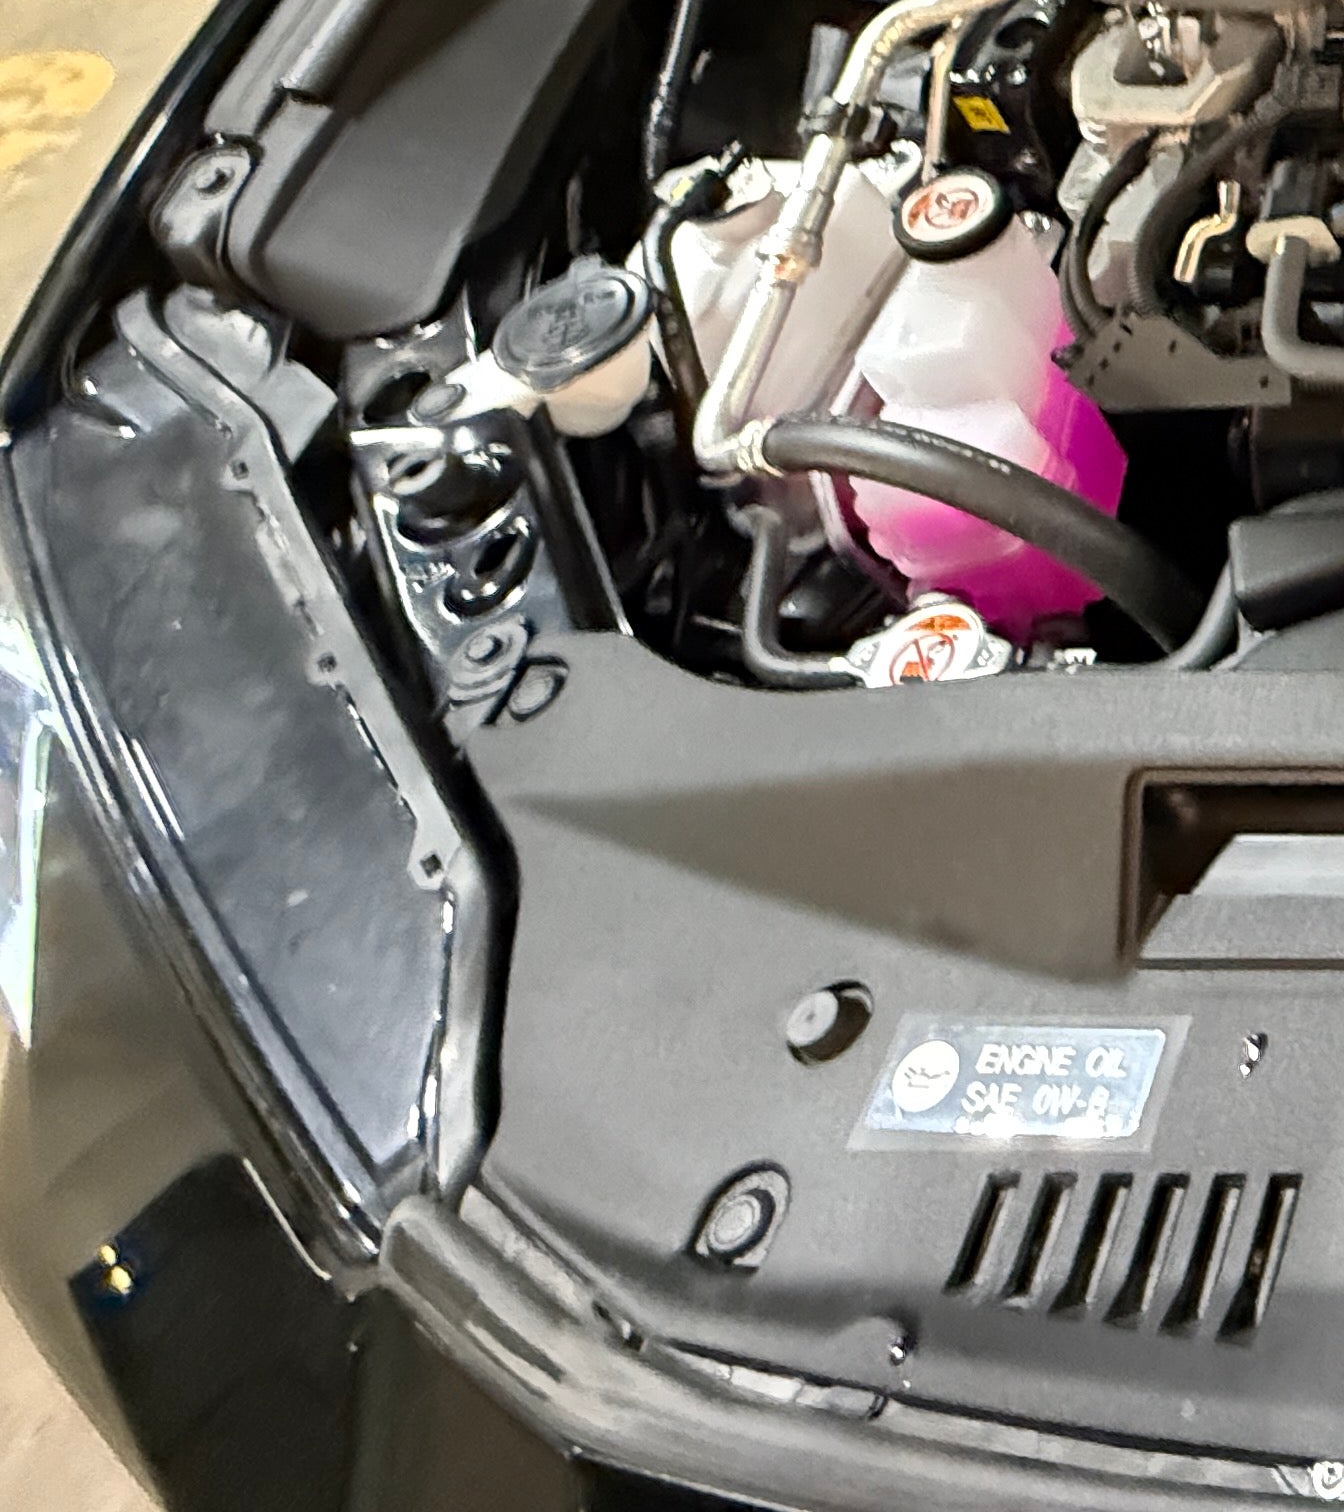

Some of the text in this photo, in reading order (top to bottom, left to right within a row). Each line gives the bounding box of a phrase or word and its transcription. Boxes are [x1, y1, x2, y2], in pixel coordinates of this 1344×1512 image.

[975, 1043, 1127, 1078] ENGINE OIL
[961, 1081, 1023, 1115] SAE
